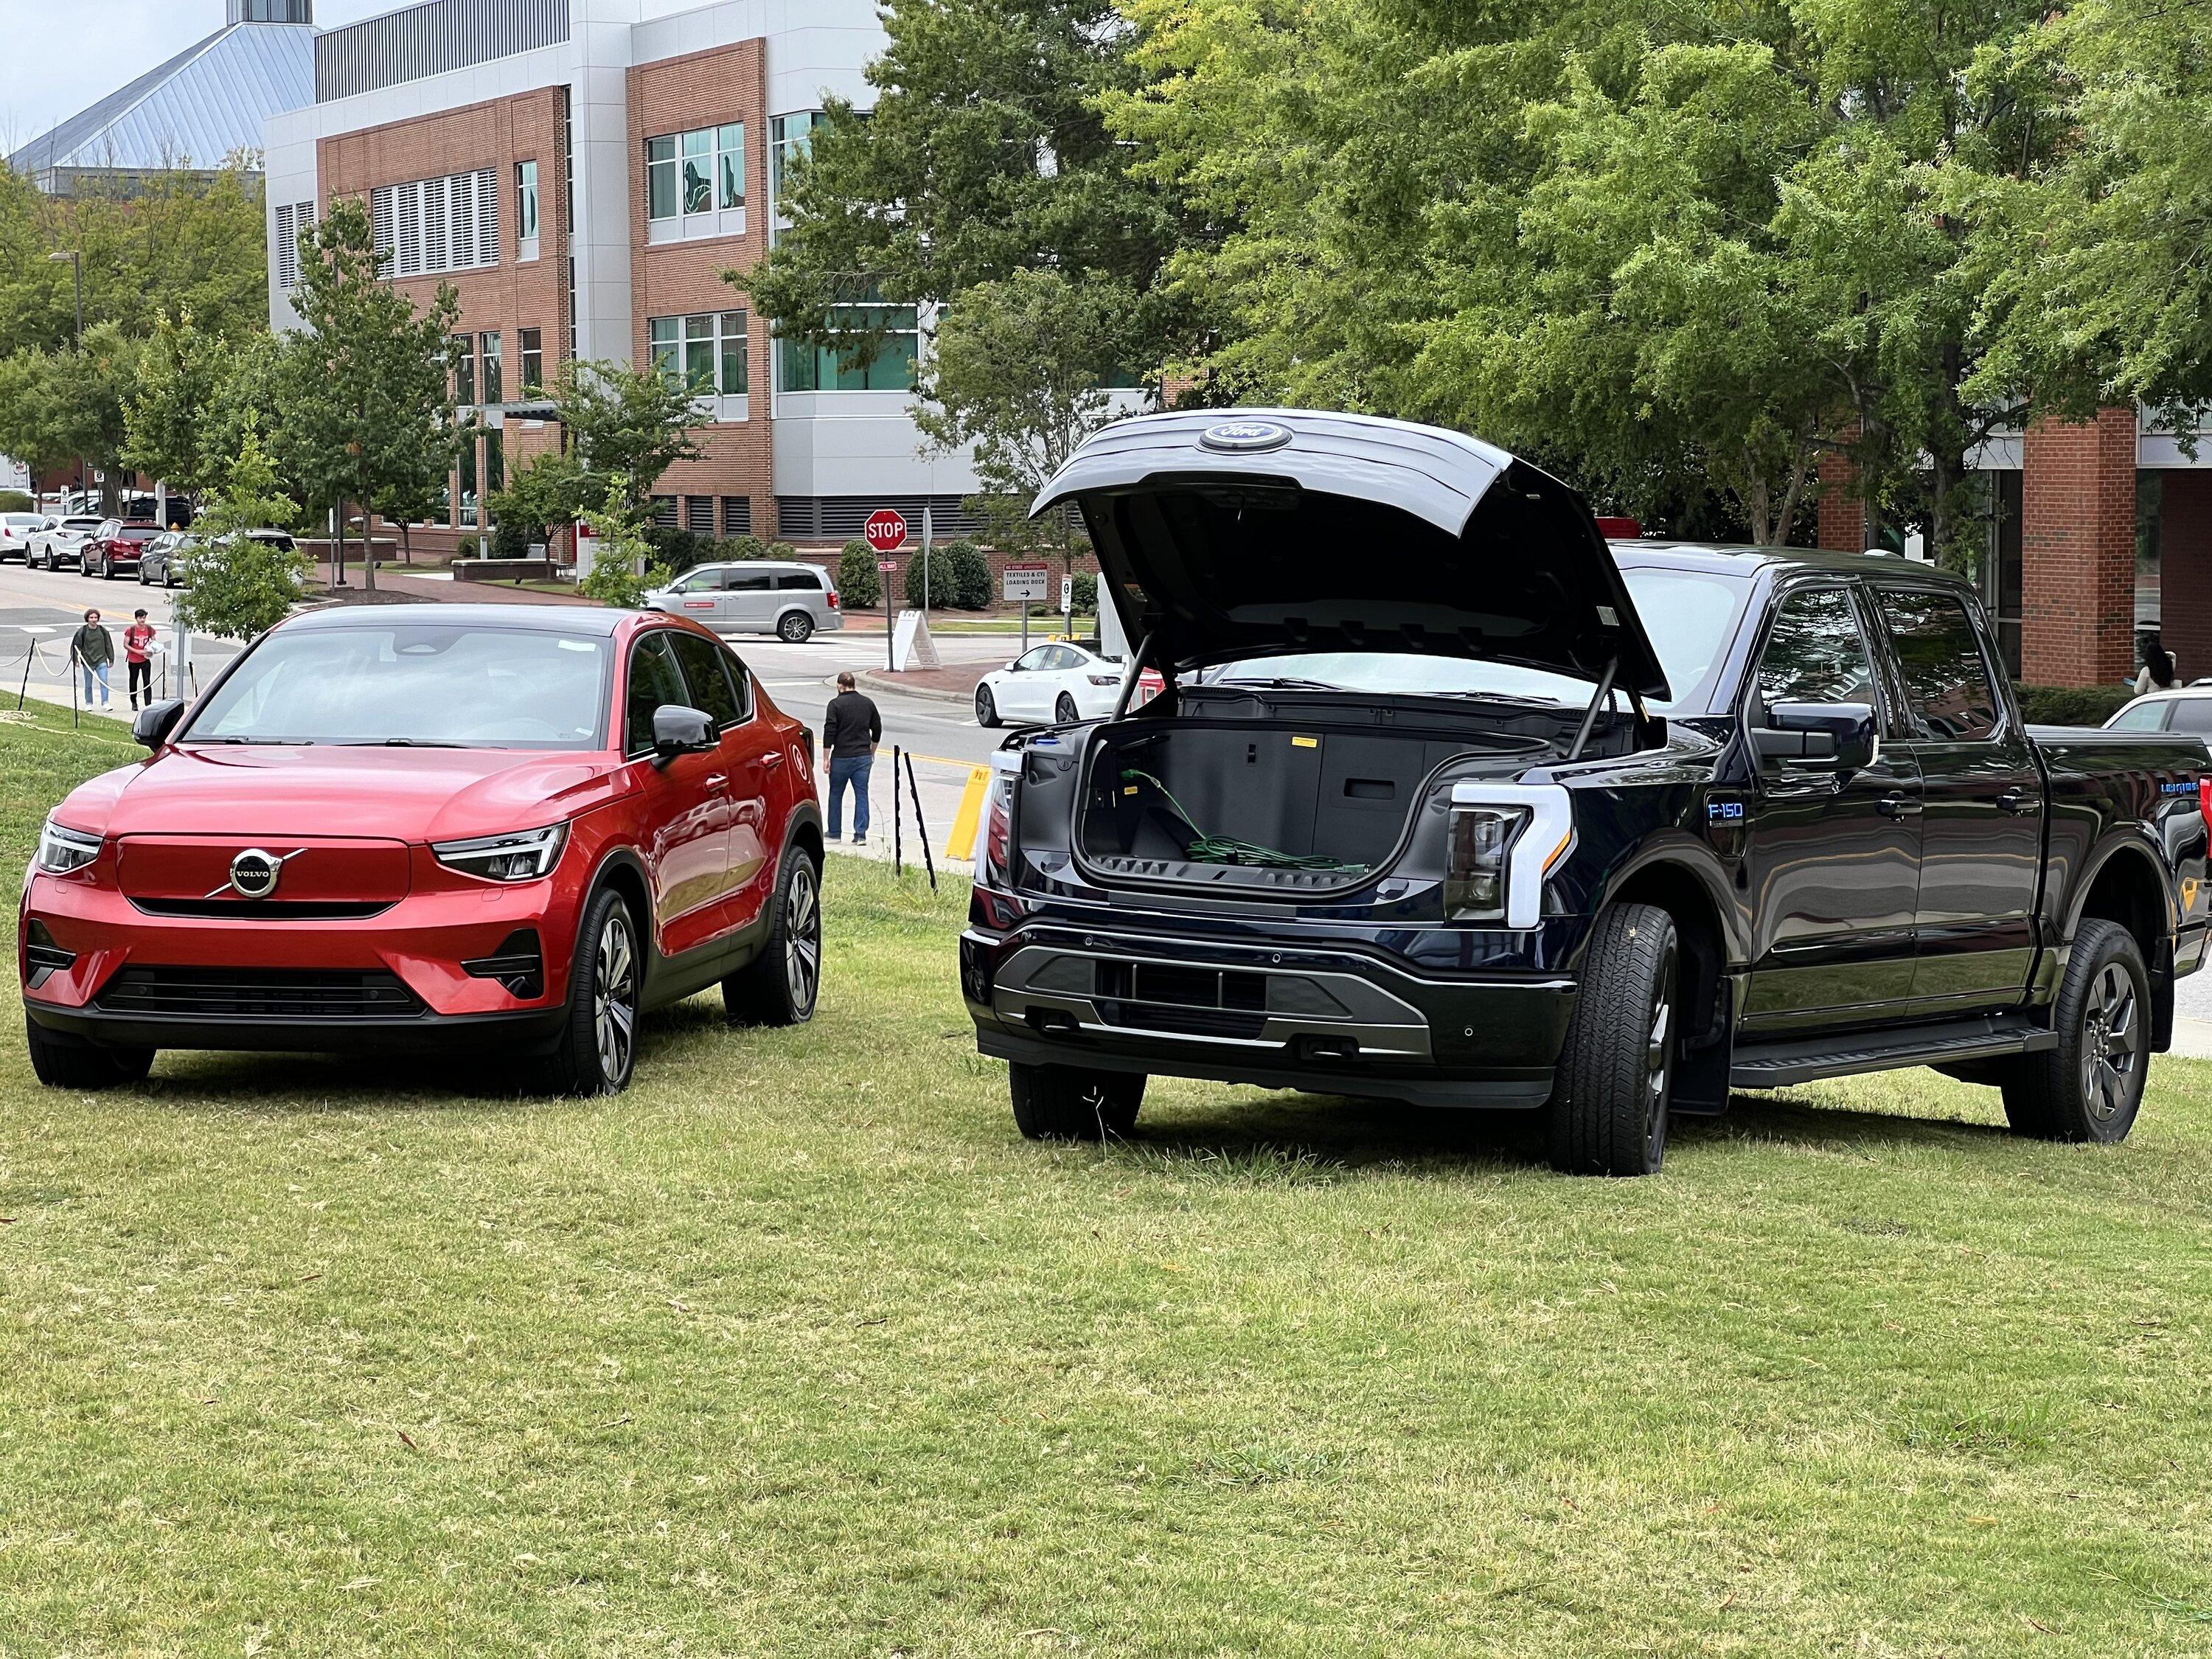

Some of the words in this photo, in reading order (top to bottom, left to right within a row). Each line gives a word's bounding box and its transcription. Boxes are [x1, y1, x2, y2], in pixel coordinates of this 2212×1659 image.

[1220, 425, 1265, 437] Ford
[869, 522, 903, 538] STOP
[1708, 802, 1743, 818] F-150
